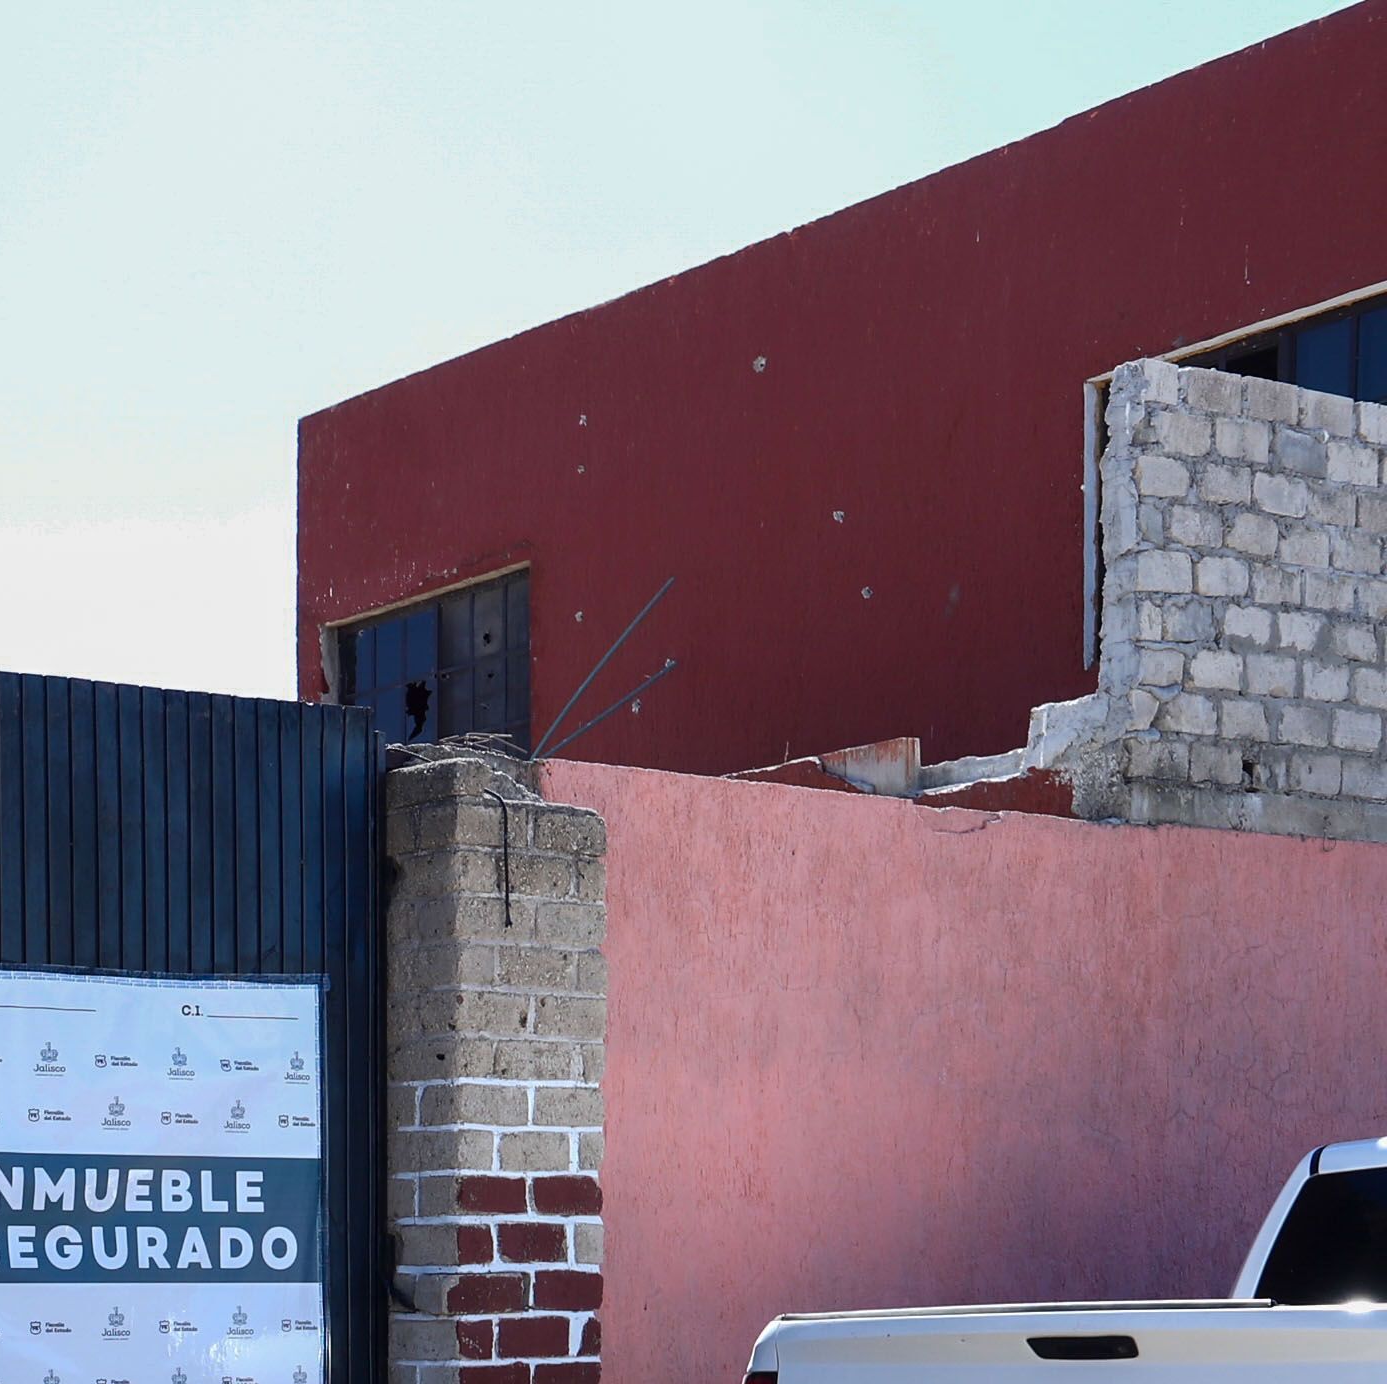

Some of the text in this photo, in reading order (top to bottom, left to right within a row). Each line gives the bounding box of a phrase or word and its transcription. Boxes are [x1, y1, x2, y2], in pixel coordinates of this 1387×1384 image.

[182, 1005, 203, 1016] C.I.
[33, 1064, 66, 1072] Jalisco
[167, 1068, 195, 1076] Jalisco
[284, 1072, 310, 1081] Jalisco
[101, 1118, 131, 1126] Jalisco
[224, 1121, 250, 1129] Jalisco
[102, 1328, 130, 1336] Jalisco
[227, 1327, 254, 1335] Jalisco
